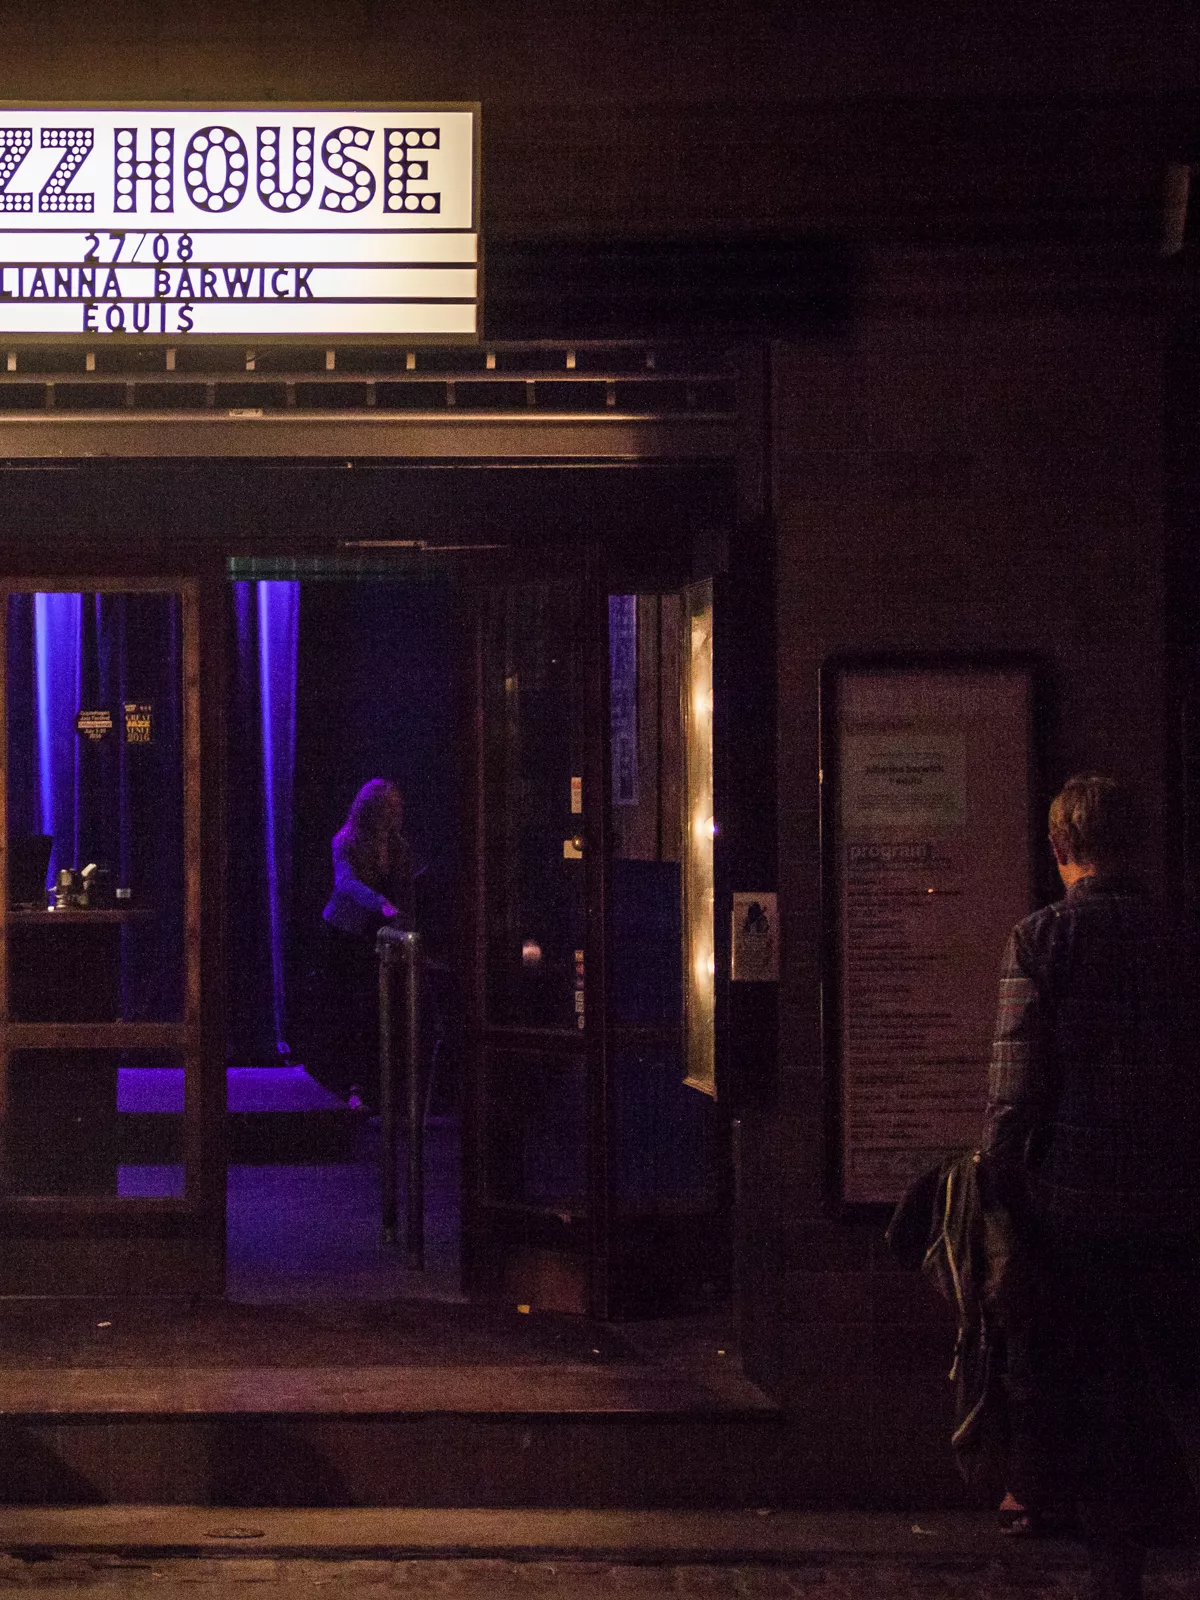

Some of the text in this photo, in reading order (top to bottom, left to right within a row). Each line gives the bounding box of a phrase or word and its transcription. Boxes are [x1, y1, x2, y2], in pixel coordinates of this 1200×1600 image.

[83, 232, 196, 263] 27/08
[156, 267, 315, 298] BARWICK
[82, 303, 196, 332] EQUIS
[127, 733, 150, 742] 2016
